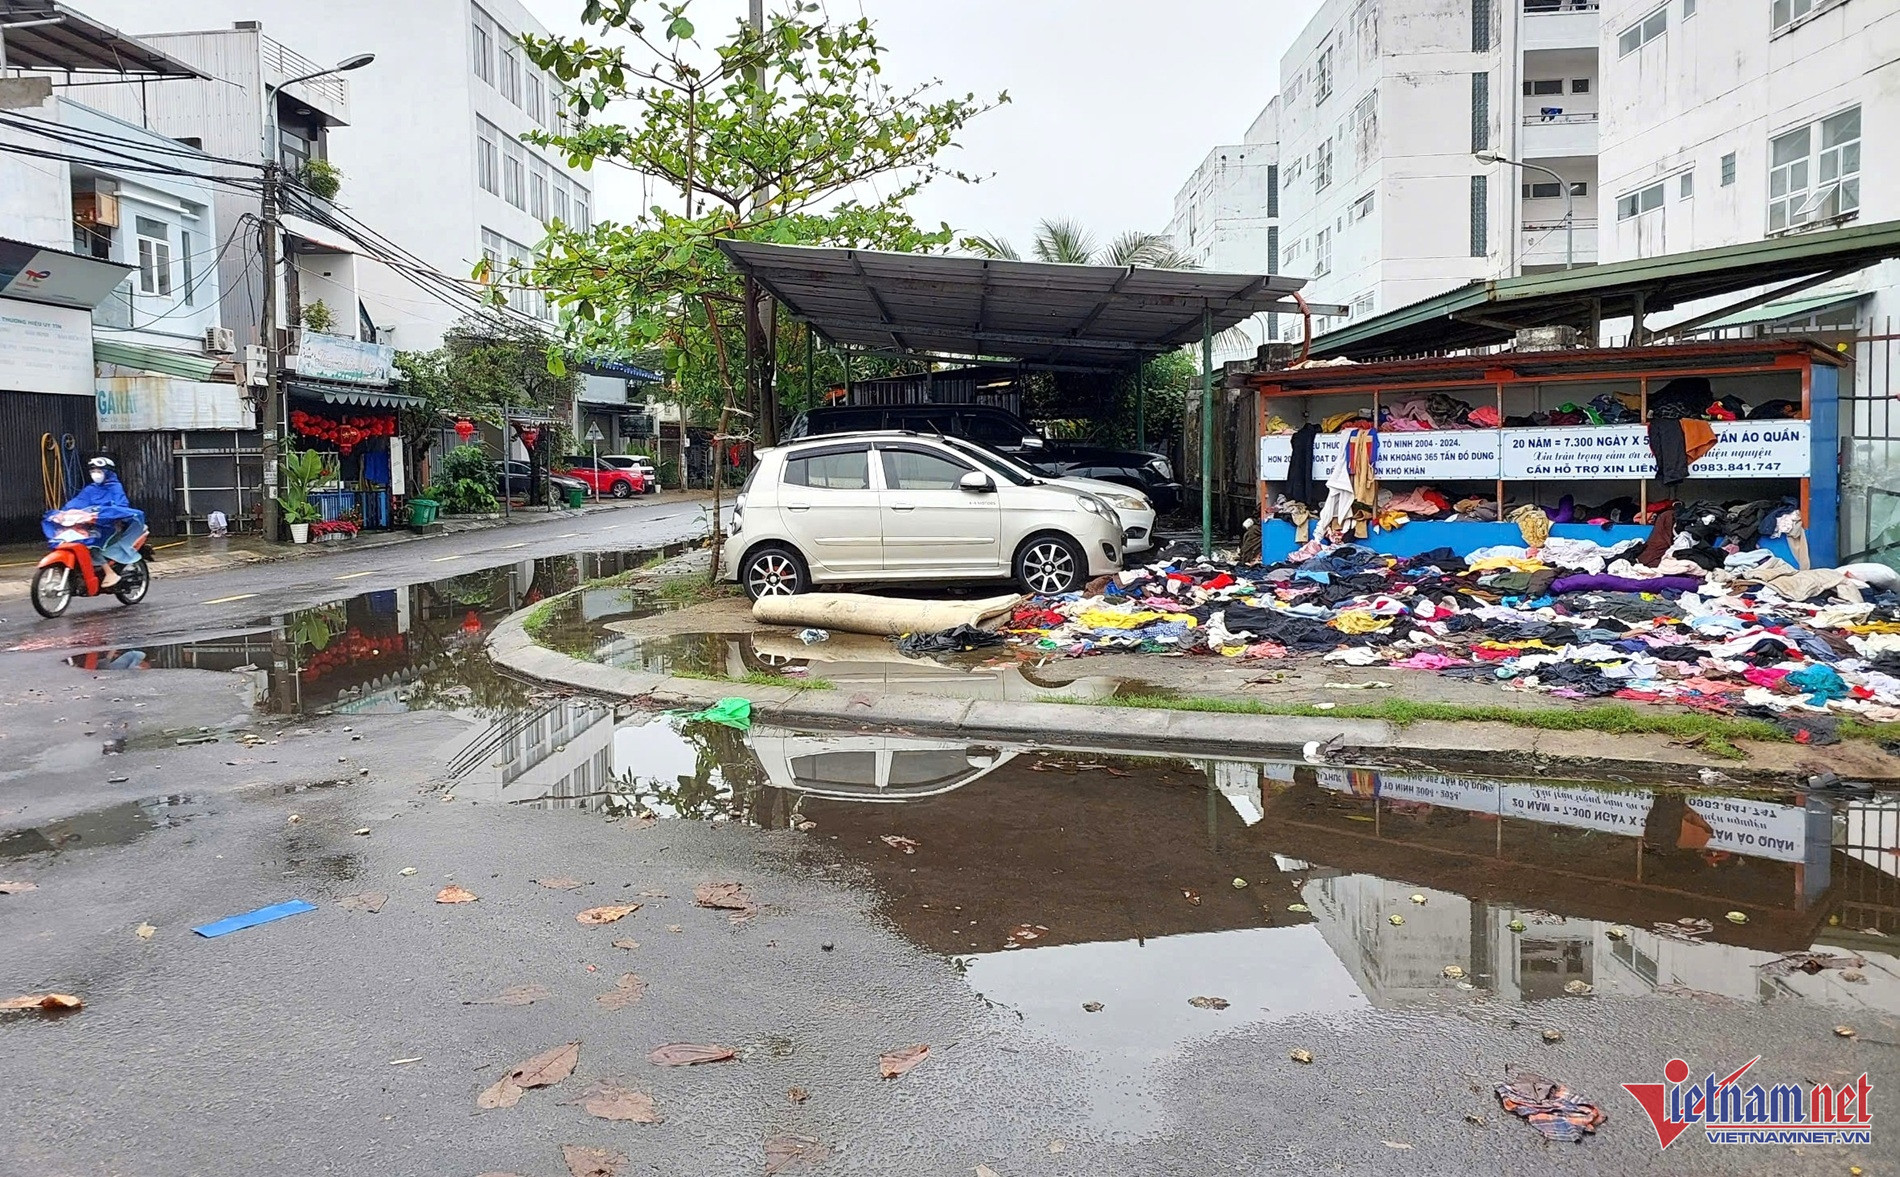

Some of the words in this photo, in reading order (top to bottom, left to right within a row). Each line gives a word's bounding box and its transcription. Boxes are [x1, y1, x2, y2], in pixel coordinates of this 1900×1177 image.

[1394, 440, 1413, 448] NINH
[1415, 439, 1433, 447] 2004
[1440, 438, 1461, 447] 2024.
[1512, 439, 1525, 449] 20
[1528, 436, 1552, 448] NĂM
[1564, 437, 1593, 447] 7.300
[1596, 434, 1628, 447] NGÀY
[1632, 435, 1640, 446] X
[1643, 435, 1650, 445] 5
[1741, 430, 1759, 443] ÁO
[1763, 427, 1799, 443] QUẦN
[1424, 453, 1438, 461] 365
[1440, 449, 1456, 460] TẤN
[1533, 450, 1552, 461] Xin
[1577, 452, 1603, 463] trọng
[1628, 451, 1641, 459] ơn
[1702, 448, 1728, 460] hiện
[1731, 447, 1772, 460] nguyện
[1526, 463, 1551, 474] CẦN
[1554, 462, 1571, 474] HỖ
[1574, 464, 1600, 475] TRỢ
[1603, 465, 1624, 473] XIN
[1629, 463, 1659, 473] LIÊN
[1692, 462, 1781, 472] 0983.841.747
